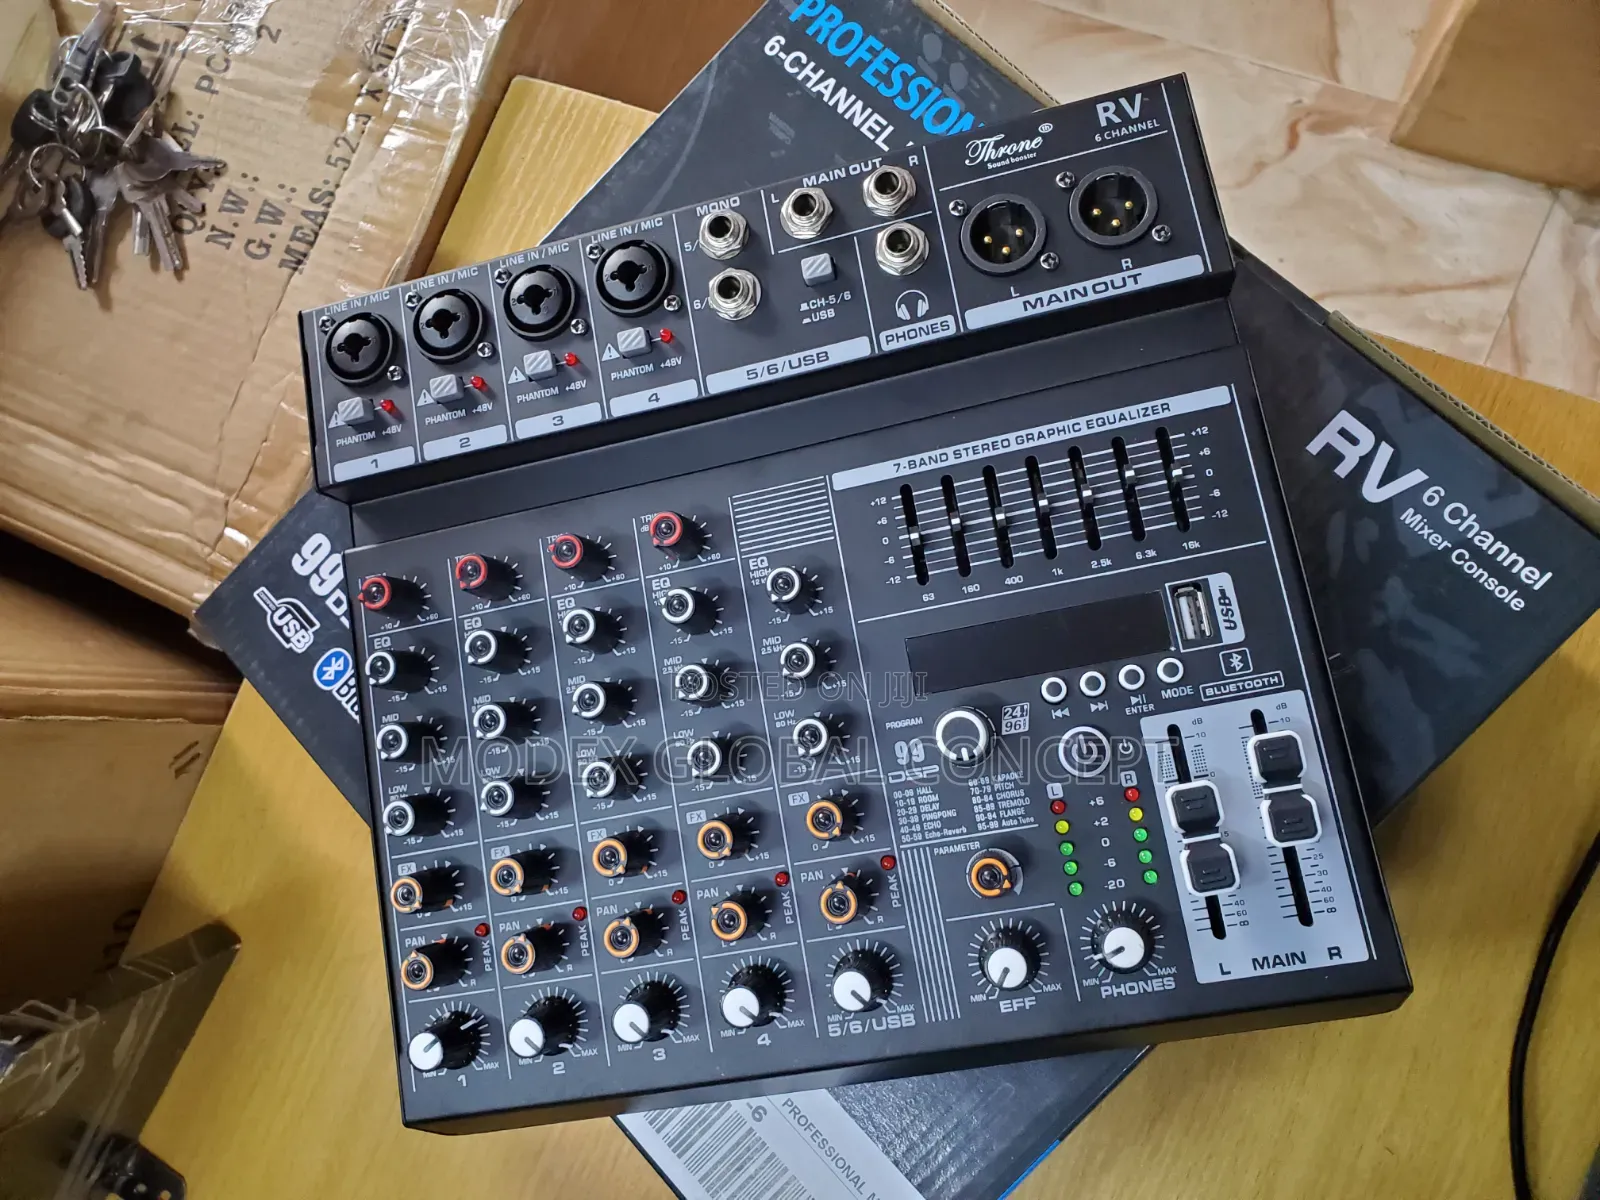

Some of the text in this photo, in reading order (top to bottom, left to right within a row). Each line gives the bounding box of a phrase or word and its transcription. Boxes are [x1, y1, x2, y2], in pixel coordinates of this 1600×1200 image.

[764, 35, 896, 152] 6-CHANNEL
[1096, 93, 1142, 127] RV
[1095, 118, 1160, 142] 6 CHANNEL
[965, 134, 1043, 166] Throne
[908, 155, 918, 166] R
[802, 158, 882, 188] MAIN OUT
[620, 224, 632, 236] IN
[641, 217, 663, 231] MIC
[527, 249, 539, 260] IN
[548, 242, 570, 256] MIC
[1121, 258, 1132, 269] R
[438, 274, 449, 284] IN
[457, 267, 479, 281] MIC
[1022, 273, 1142, 312] MAIN OUT
[324, 291, 390, 315] LINE IN MIC
[809, 290, 852, 310] CH-5/6
[812, 308, 836, 322] USB
[884, 320, 950, 346] PHONES
[611, 356, 683, 380] PHANTOM +48V
[746, 351, 830, 380] 5/6/USB
[516, 380, 587, 403] PHANTOM +48V
[648, 393, 660, 403] 4
[425, 403, 493, 425] PHANTOM +48V
[552, 415, 564, 426] 3
[336, 425, 402, 447] PHANTOM +48V
[893, 403, 1171, 473] 7-BAND STEREO GRAPHIC EQUALIZER
[1191, 427, 1209, 437] +12
[459, 437, 471, 448] 2
[1199, 448, 1211, 456] +6
[1306, 410, 1430, 504] RV
[877, 517, 888, 526] +6
[1422, 486, 1552, 590] 6 Channel
[749, 556, 768, 570] EQ
[1400, 508, 1525, 611] Mixer Console
[922, 541, 1201, 602] 63 160 400 1k 2.5k 16k
[652, 577, 671, 591] EQ
[557, 597, 575, 611] EQ
[273, 606, 312, 649] USB
[464, 617, 482, 630] EQ
[374, 637, 391, 649] EQ
[762, 636, 782, 646] MID
[664, 656, 682, 666] MID
[567, 676, 586, 686] MID
[1206, 676, 1279, 696] BLUETOOTH
[1161, 685, 1194, 699] MODE
[473, 694, 491, 705] MID
[774, 710, 795, 720] LOW
[1004, 707, 1022, 720] 24
[1125, 703, 1155, 715] ENTER
[382, 713, 399, 722] MID
[886, 717, 923, 730] PROGRAM
[1005, 720, 1022, 732] 96
[673, 728, 694, 739] LOW
[894, 738, 925, 765] 99
[888, 765, 939, 783] DSP
[388, 784, 408, 794] LOW
[916, 786, 933, 795] HALL
[994, 782, 1014, 791] PITCH
[918, 794, 939, 803] ROOM
[996, 790, 1024, 800] CHORUS
[1089, 797, 1104, 806] +6
[920, 803, 940, 813] DELAY
[998, 798, 1030, 809] TREMOLO
[922, 809, 956, 821] PINGPONG
[1000, 808, 1025, 818] FLANGE
[924, 821, 941, 830] ECHO
[902, 826, 966, 843] 50-59 Echo-Reverb
[934, 842, 980, 855] PARAMETER
[801, 870, 901, 908] PAN PEAK
[697, 888, 794, 924] PAN PEAK
[596, 905, 690, 941] PAN PEAK
[500, 921, 590, 956] PAN PEAK
[405, 936, 492, 971] PAN PEAK
[1252, 945, 1342, 971] MAIN R
[1158, 966, 1177, 975] MAX
[1043, 983, 1062, 993] MAX
[1100, 977, 1176, 999] PHONES
[897, 1004, 915, 1012] MAX
[1000, 996, 1037, 1013] EFF
[787, 1020, 805, 1028] MAX
[828, 1014, 916, 1037] 5/6/USB
[618, 1034, 700, 1052] MIN MAX
[757, 1034, 772, 1046] 4
[653, 1049, 666, 1061] 3
[552, 1062, 566, 1074] 2
[781, 1098, 865, 1195] PROFESSIONAL
